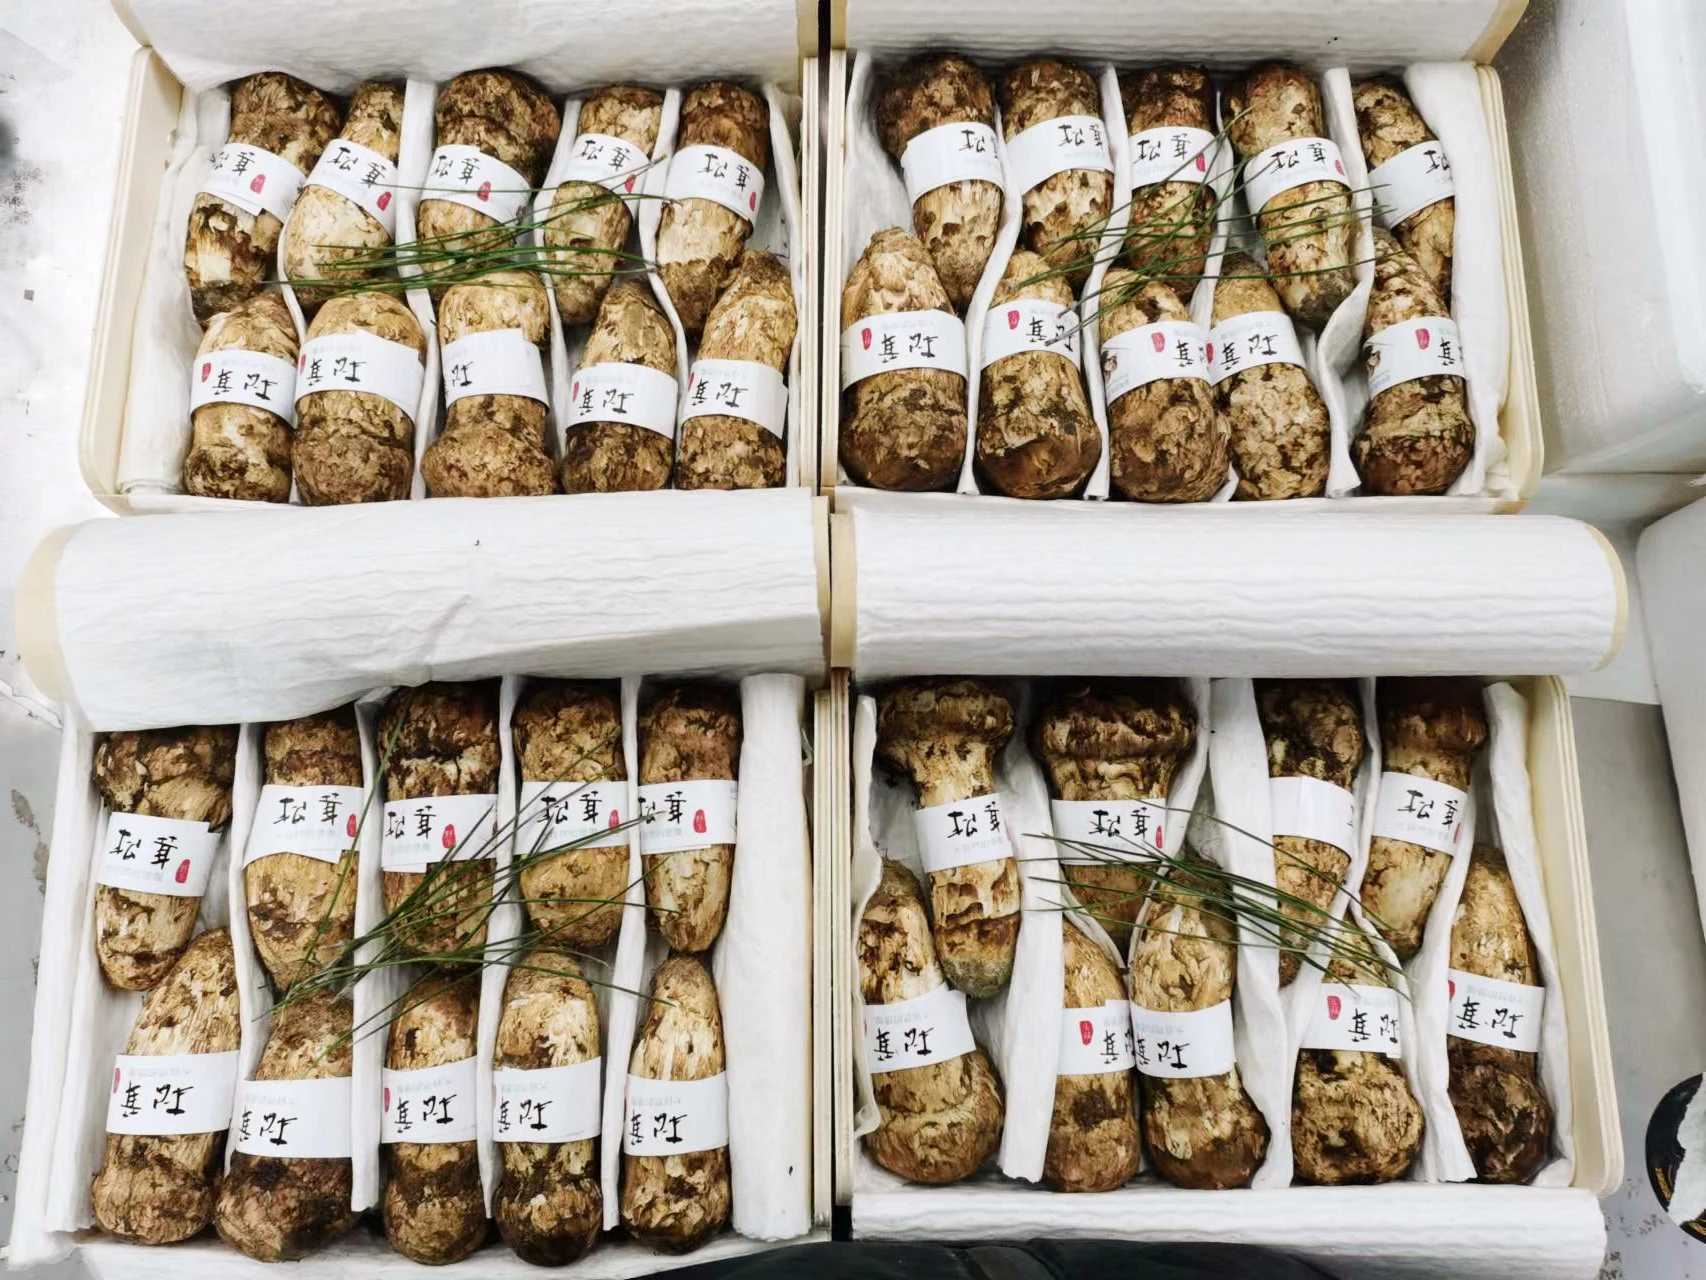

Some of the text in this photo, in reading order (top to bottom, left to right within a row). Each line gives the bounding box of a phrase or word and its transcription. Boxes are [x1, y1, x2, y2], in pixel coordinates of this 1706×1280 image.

[575, 139, 631, 171] 松茸
[1133, 133, 1192, 165] 松茸
[1270, 142, 1328, 174] 松茸
[326, 146, 387, 188] 松茸
[432, 154, 481, 184] 松茸
[697, 152, 748, 190] 松茸
[878, 333, 938, 364] 松茸
[1220, 333, 1279, 371] 松茸
[212, 367, 277, 400] 松茸
[306, 357, 366, 386] 松茸
[578, 387, 634, 416] 松茸
[691, 379, 748, 408] 松茸
[273, 793, 343, 826] 松茸
[385, 805, 437, 839] 松茸
[536, 790, 603, 825] 松茸
[637, 791, 688, 825] 松茸
[947, 801, 1000, 839] 松茸
[1088, 806, 1151, 839] 松茸
[1397, 789, 1459, 830] 松茸
[109, 829, 178, 870] 松茸
[1347, 1008, 1400, 1043] 松茸
[1456, 996, 1524, 1039] 松茸
[873, 1027, 935, 1062] 松茸
[1136, 1031, 1189, 1069] 松茸
[121, 1081, 194, 1118] 松茸
[396, 1094, 457, 1134] 松茸
[497, 1096, 553, 1134] 松茸
[239, 1105, 298, 1146] 松茸
[628, 1109, 688, 1146] 松茸
